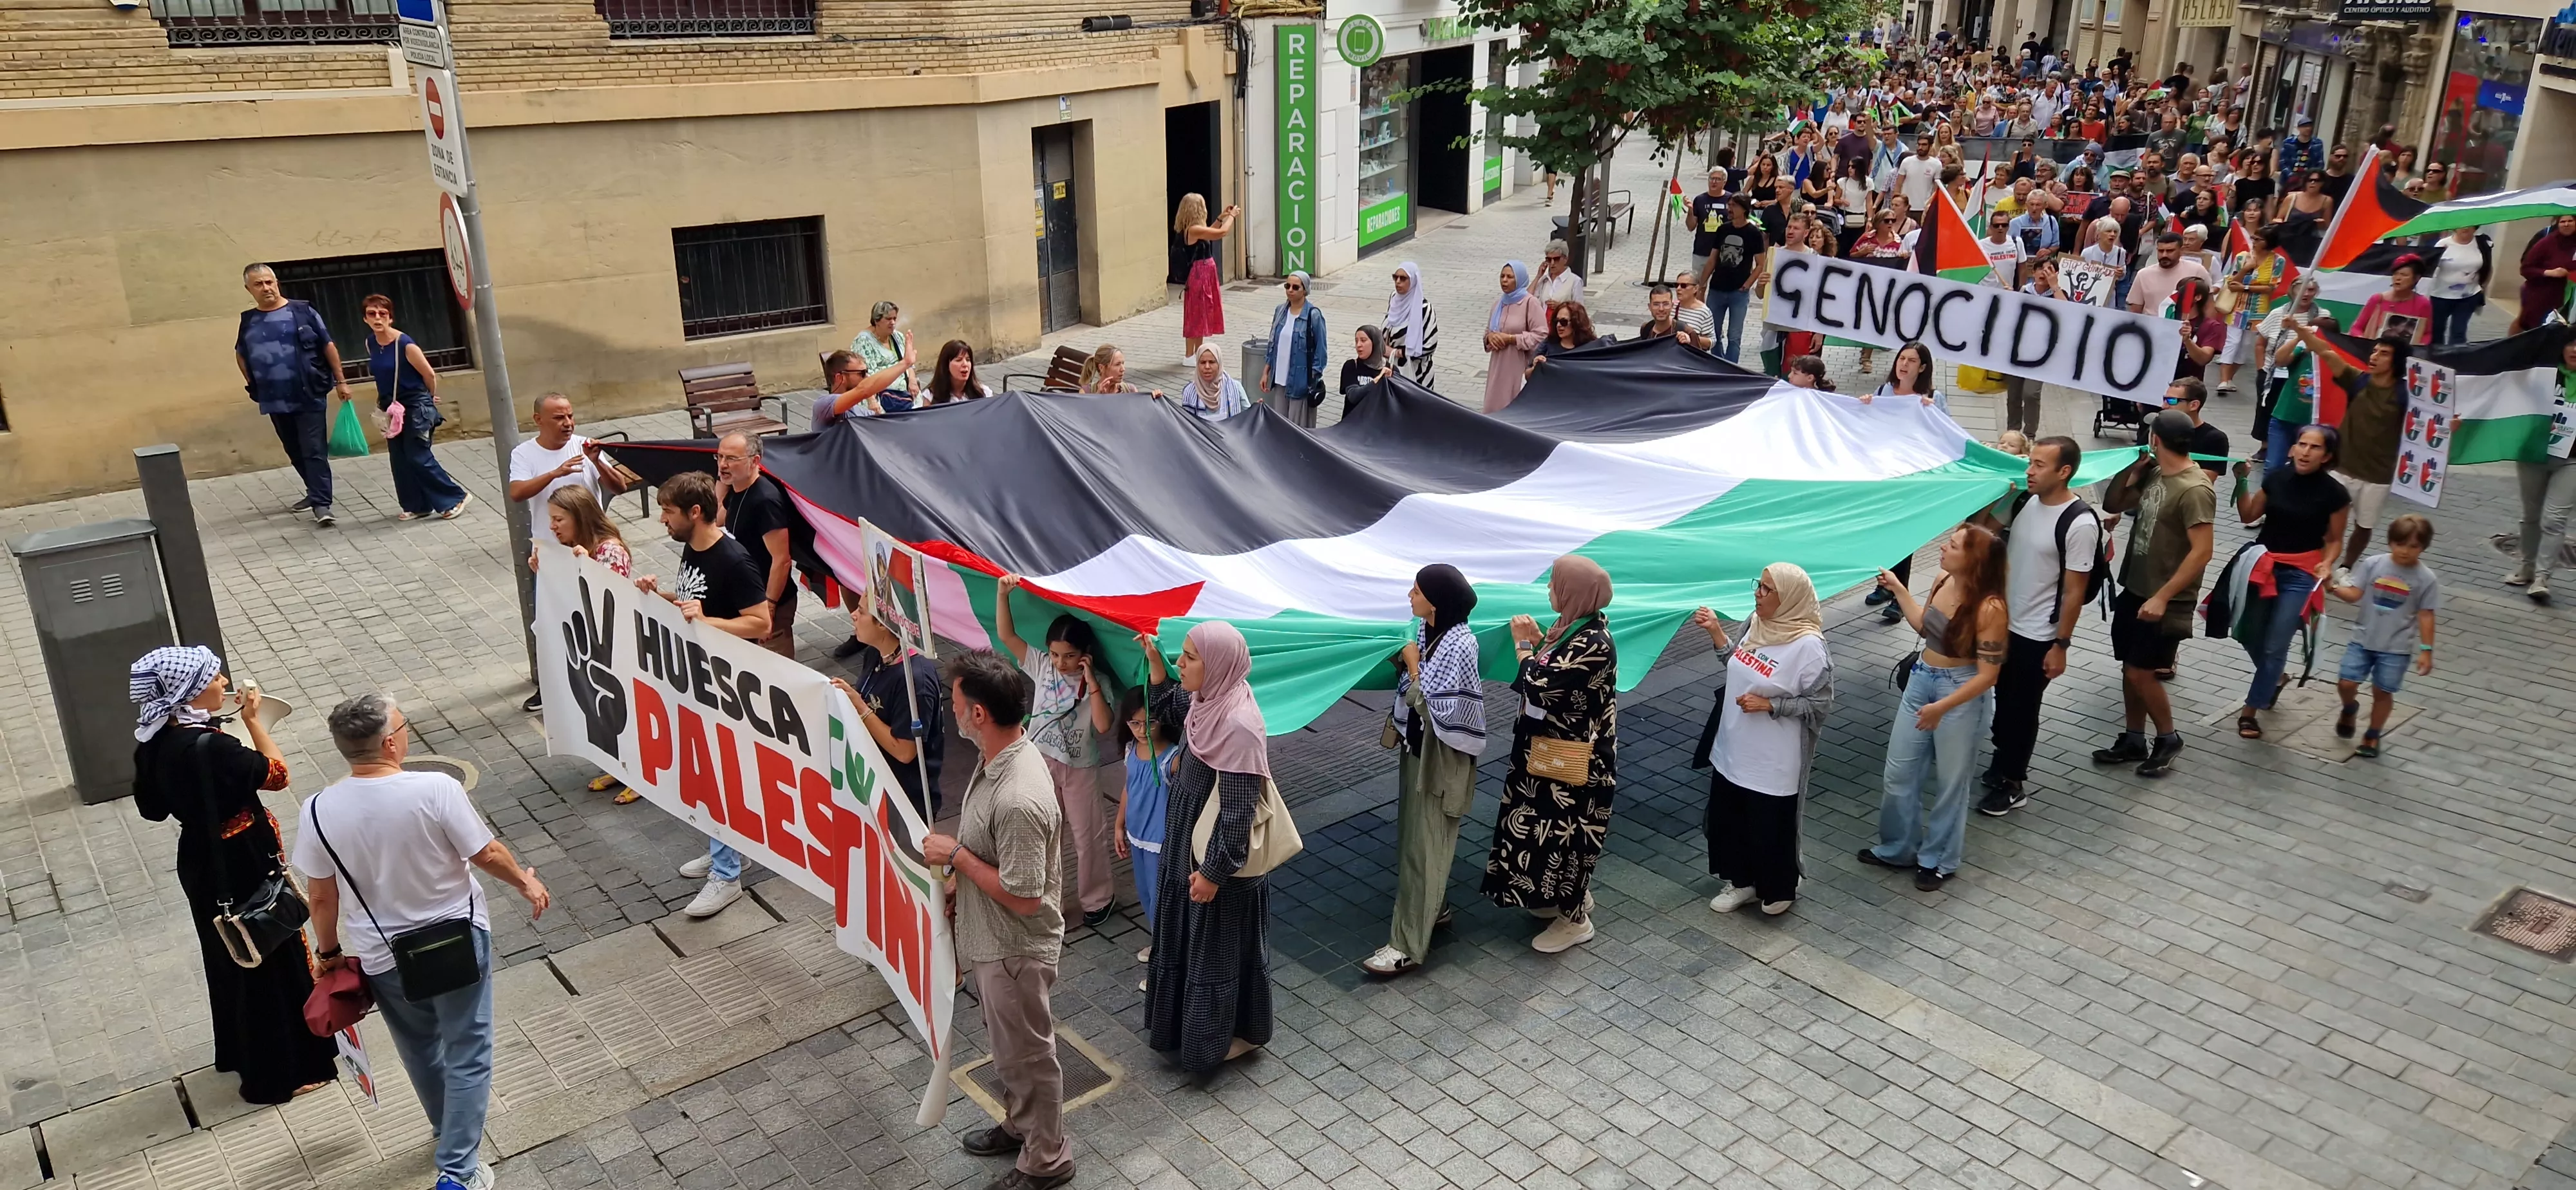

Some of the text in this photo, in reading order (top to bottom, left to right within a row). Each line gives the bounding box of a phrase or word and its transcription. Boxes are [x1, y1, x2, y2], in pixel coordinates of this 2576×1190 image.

[1347, 20, 1373, 31] PLAZA
[431, 143, 454, 165] ZONA DE
[1287, 33, 1307, 270] REPARACION
[433, 163, 458, 187] ESTANCIA
[1367, 205, 1401, 234] REPARACIONES
[2061, 259, 2082, 272] STOP
[1774, 259, 2153, 392] GENOCIDIO
[887, 606, 921, 638] GENOCIDE
[1757, 652, 1770, 663] CON
[633, 609, 812, 757] HUESCA
[633, 677, 940, 1061] PALESTIN
